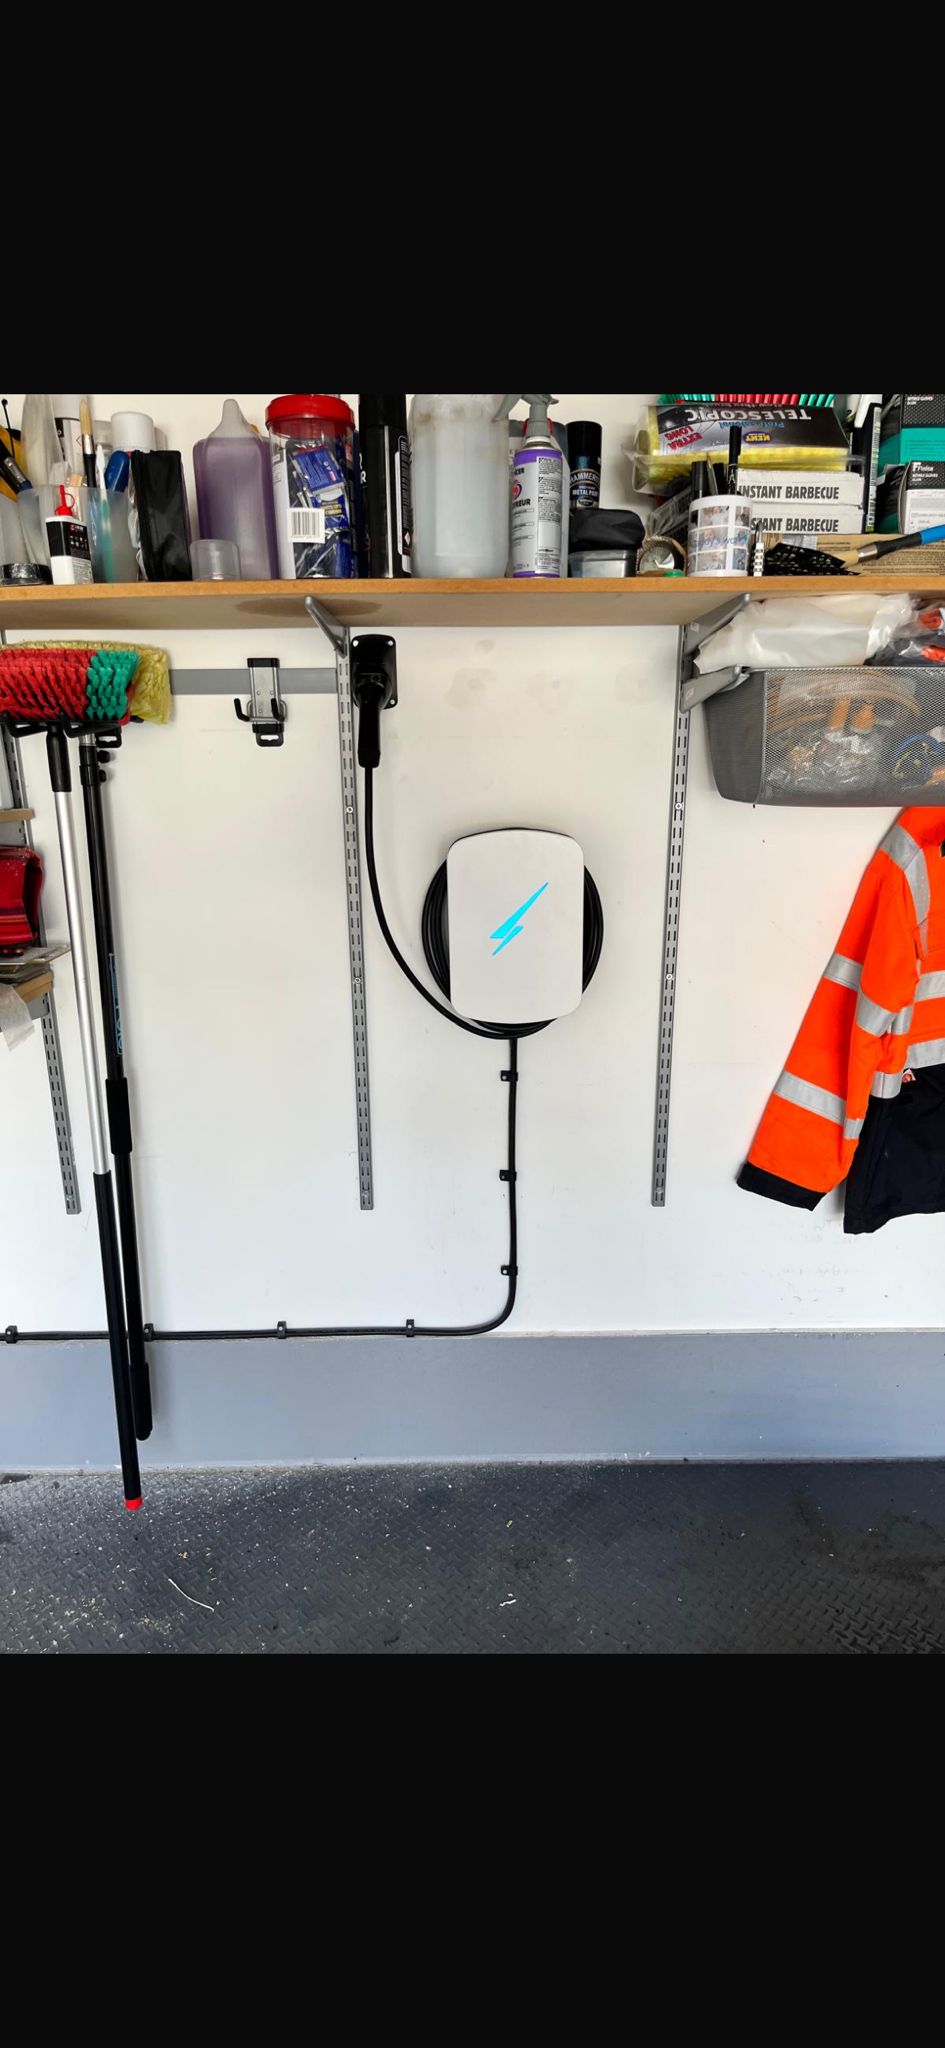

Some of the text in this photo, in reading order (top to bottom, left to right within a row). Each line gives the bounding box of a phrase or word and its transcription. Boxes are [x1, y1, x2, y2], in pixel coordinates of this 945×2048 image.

[684, 409, 812, 422] TELESCOPIC
[664, 425, 694, 441] LONG
[744, 433, 771, 442] KENT
[667, 431, 703, 451] EXTRA
[738, 485, 840, 500] INSTANT BARBECUE
[750, 517, 840, 532] SANT BARBECUE
